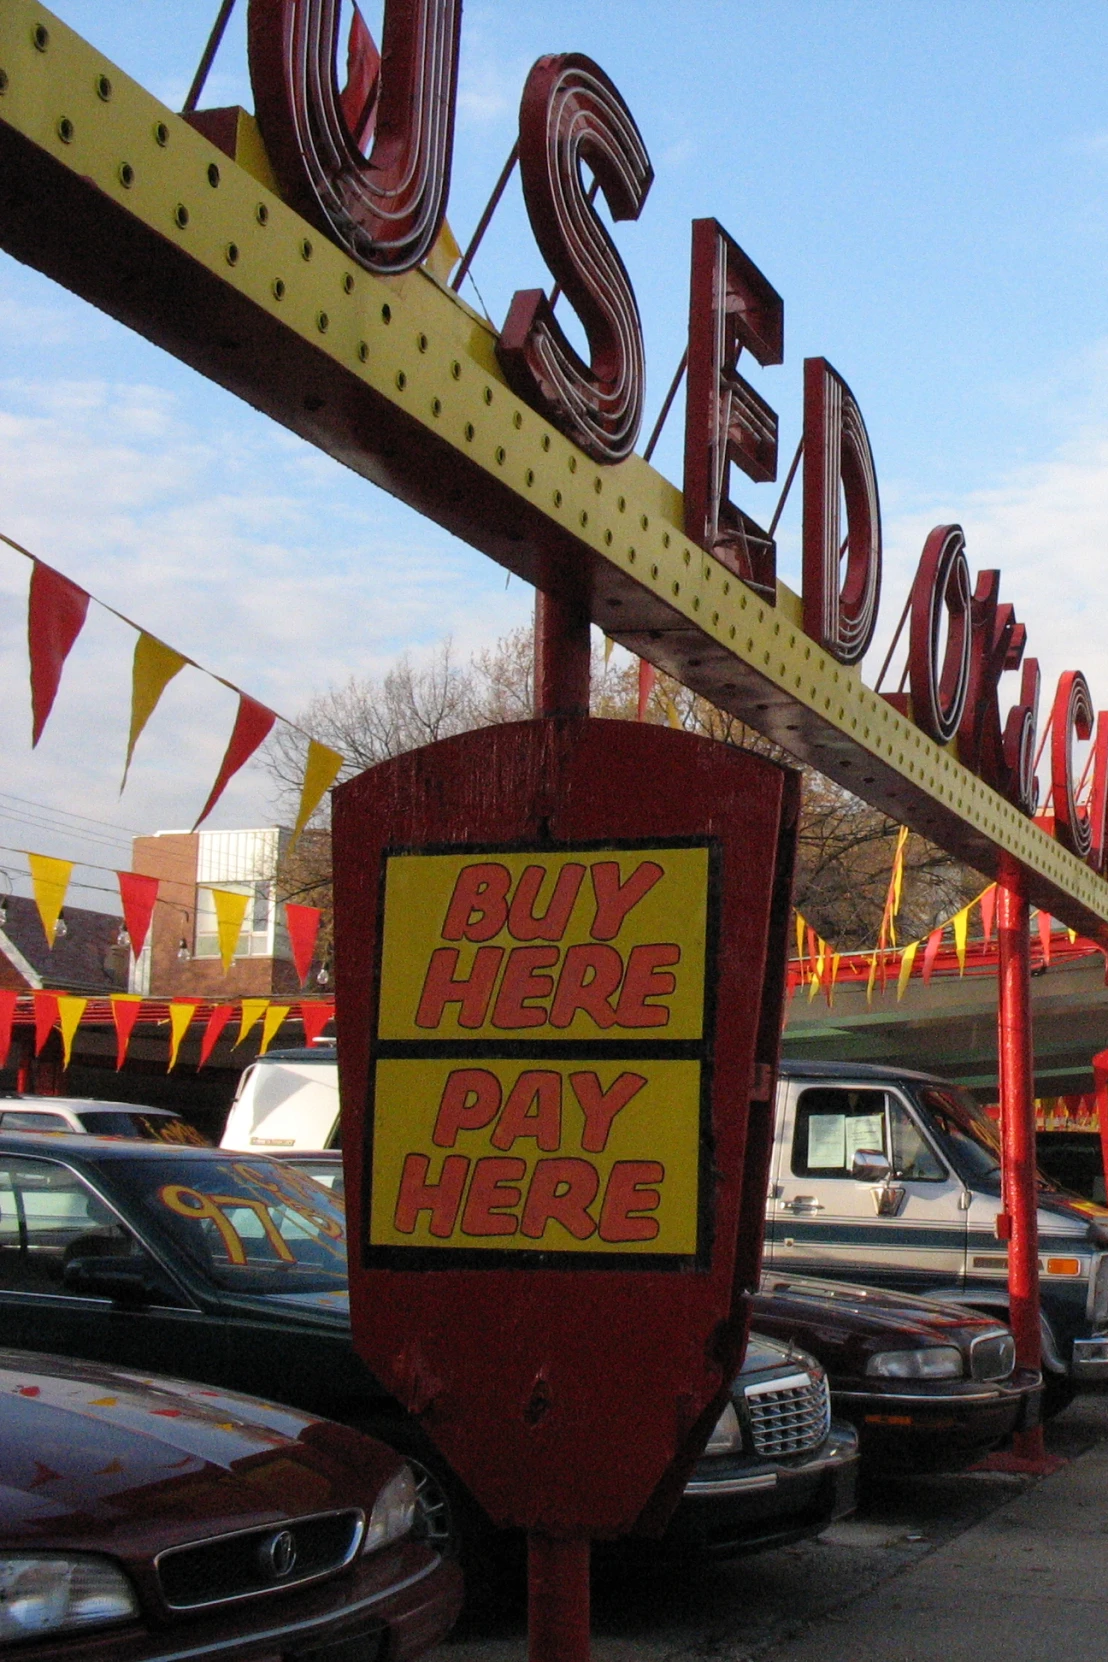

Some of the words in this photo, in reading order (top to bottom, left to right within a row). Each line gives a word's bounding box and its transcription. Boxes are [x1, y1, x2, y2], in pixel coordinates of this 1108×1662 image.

[247, 0, 883, 669] USED
[441, 861, 665, 941] BUY
[415, 943, 681, 1029] HERE
[432, 1068, 648, 1153] PAY
[159, 1185, 297, 1266] 97
[394, 1153, 665, 1243] HERE
